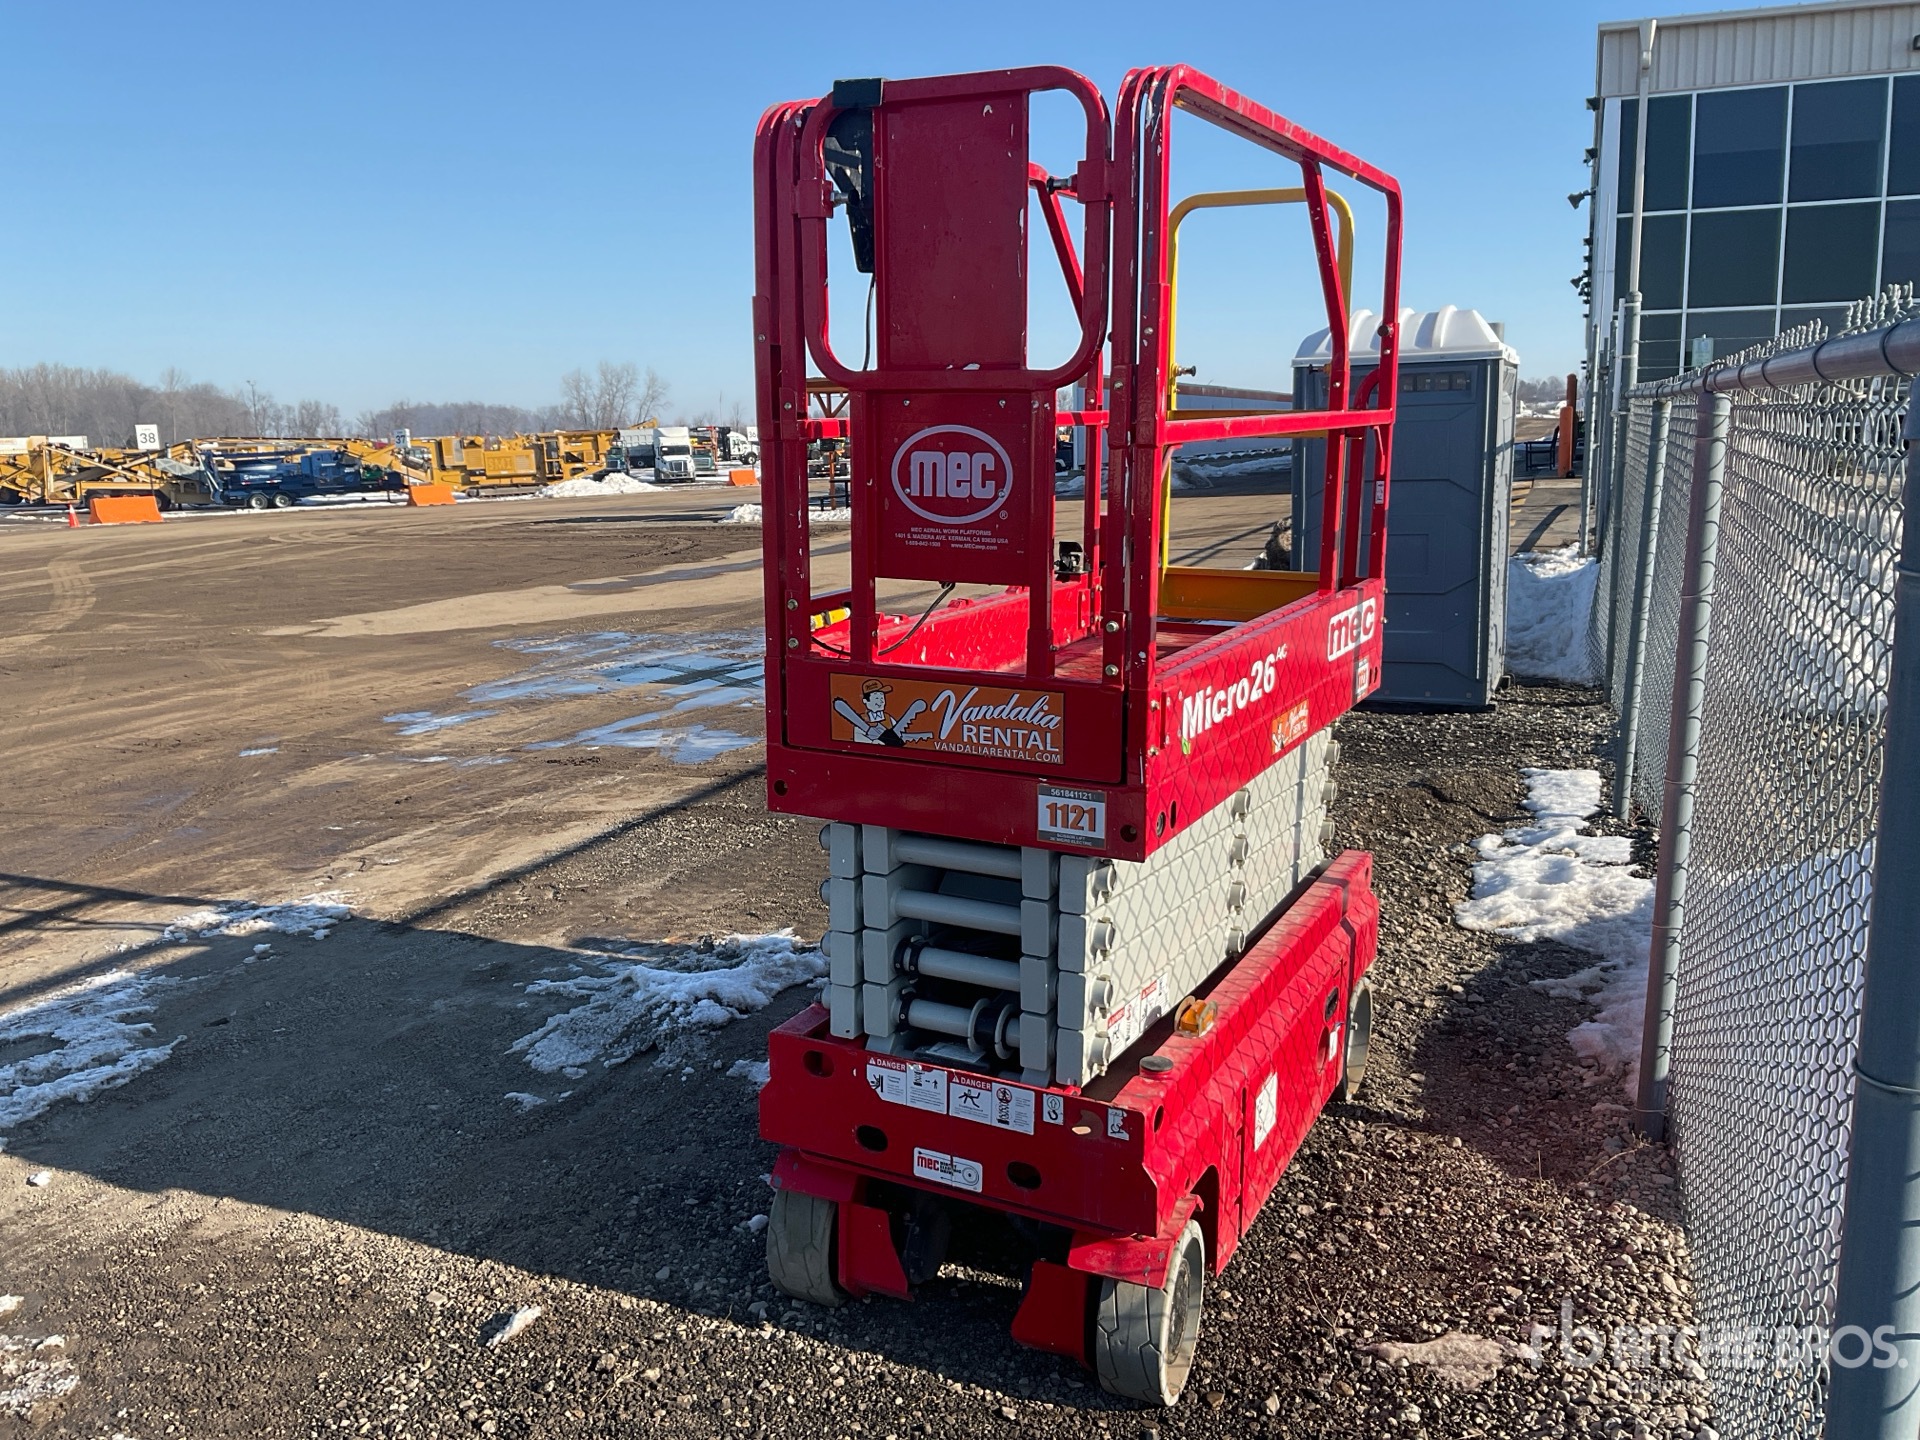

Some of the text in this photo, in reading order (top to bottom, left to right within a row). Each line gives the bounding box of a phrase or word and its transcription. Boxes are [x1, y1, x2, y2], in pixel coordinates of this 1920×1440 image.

[139, 432, 156, 444] 38
[395, 435, 406, 444] 37
[930, 687, 1062, 739] Vandalia
[962, 723, 1059, 752] RENTAL
[934, 741, 1061, 764] VANDALIARENTAL.COM
[1050, 788, 1092, 800] 561841121
[1045, 802, 1097, 832] 1121
[876, 1058, 906, 1071] DANGER
[960, 1077, 992, 1090] DANGER
